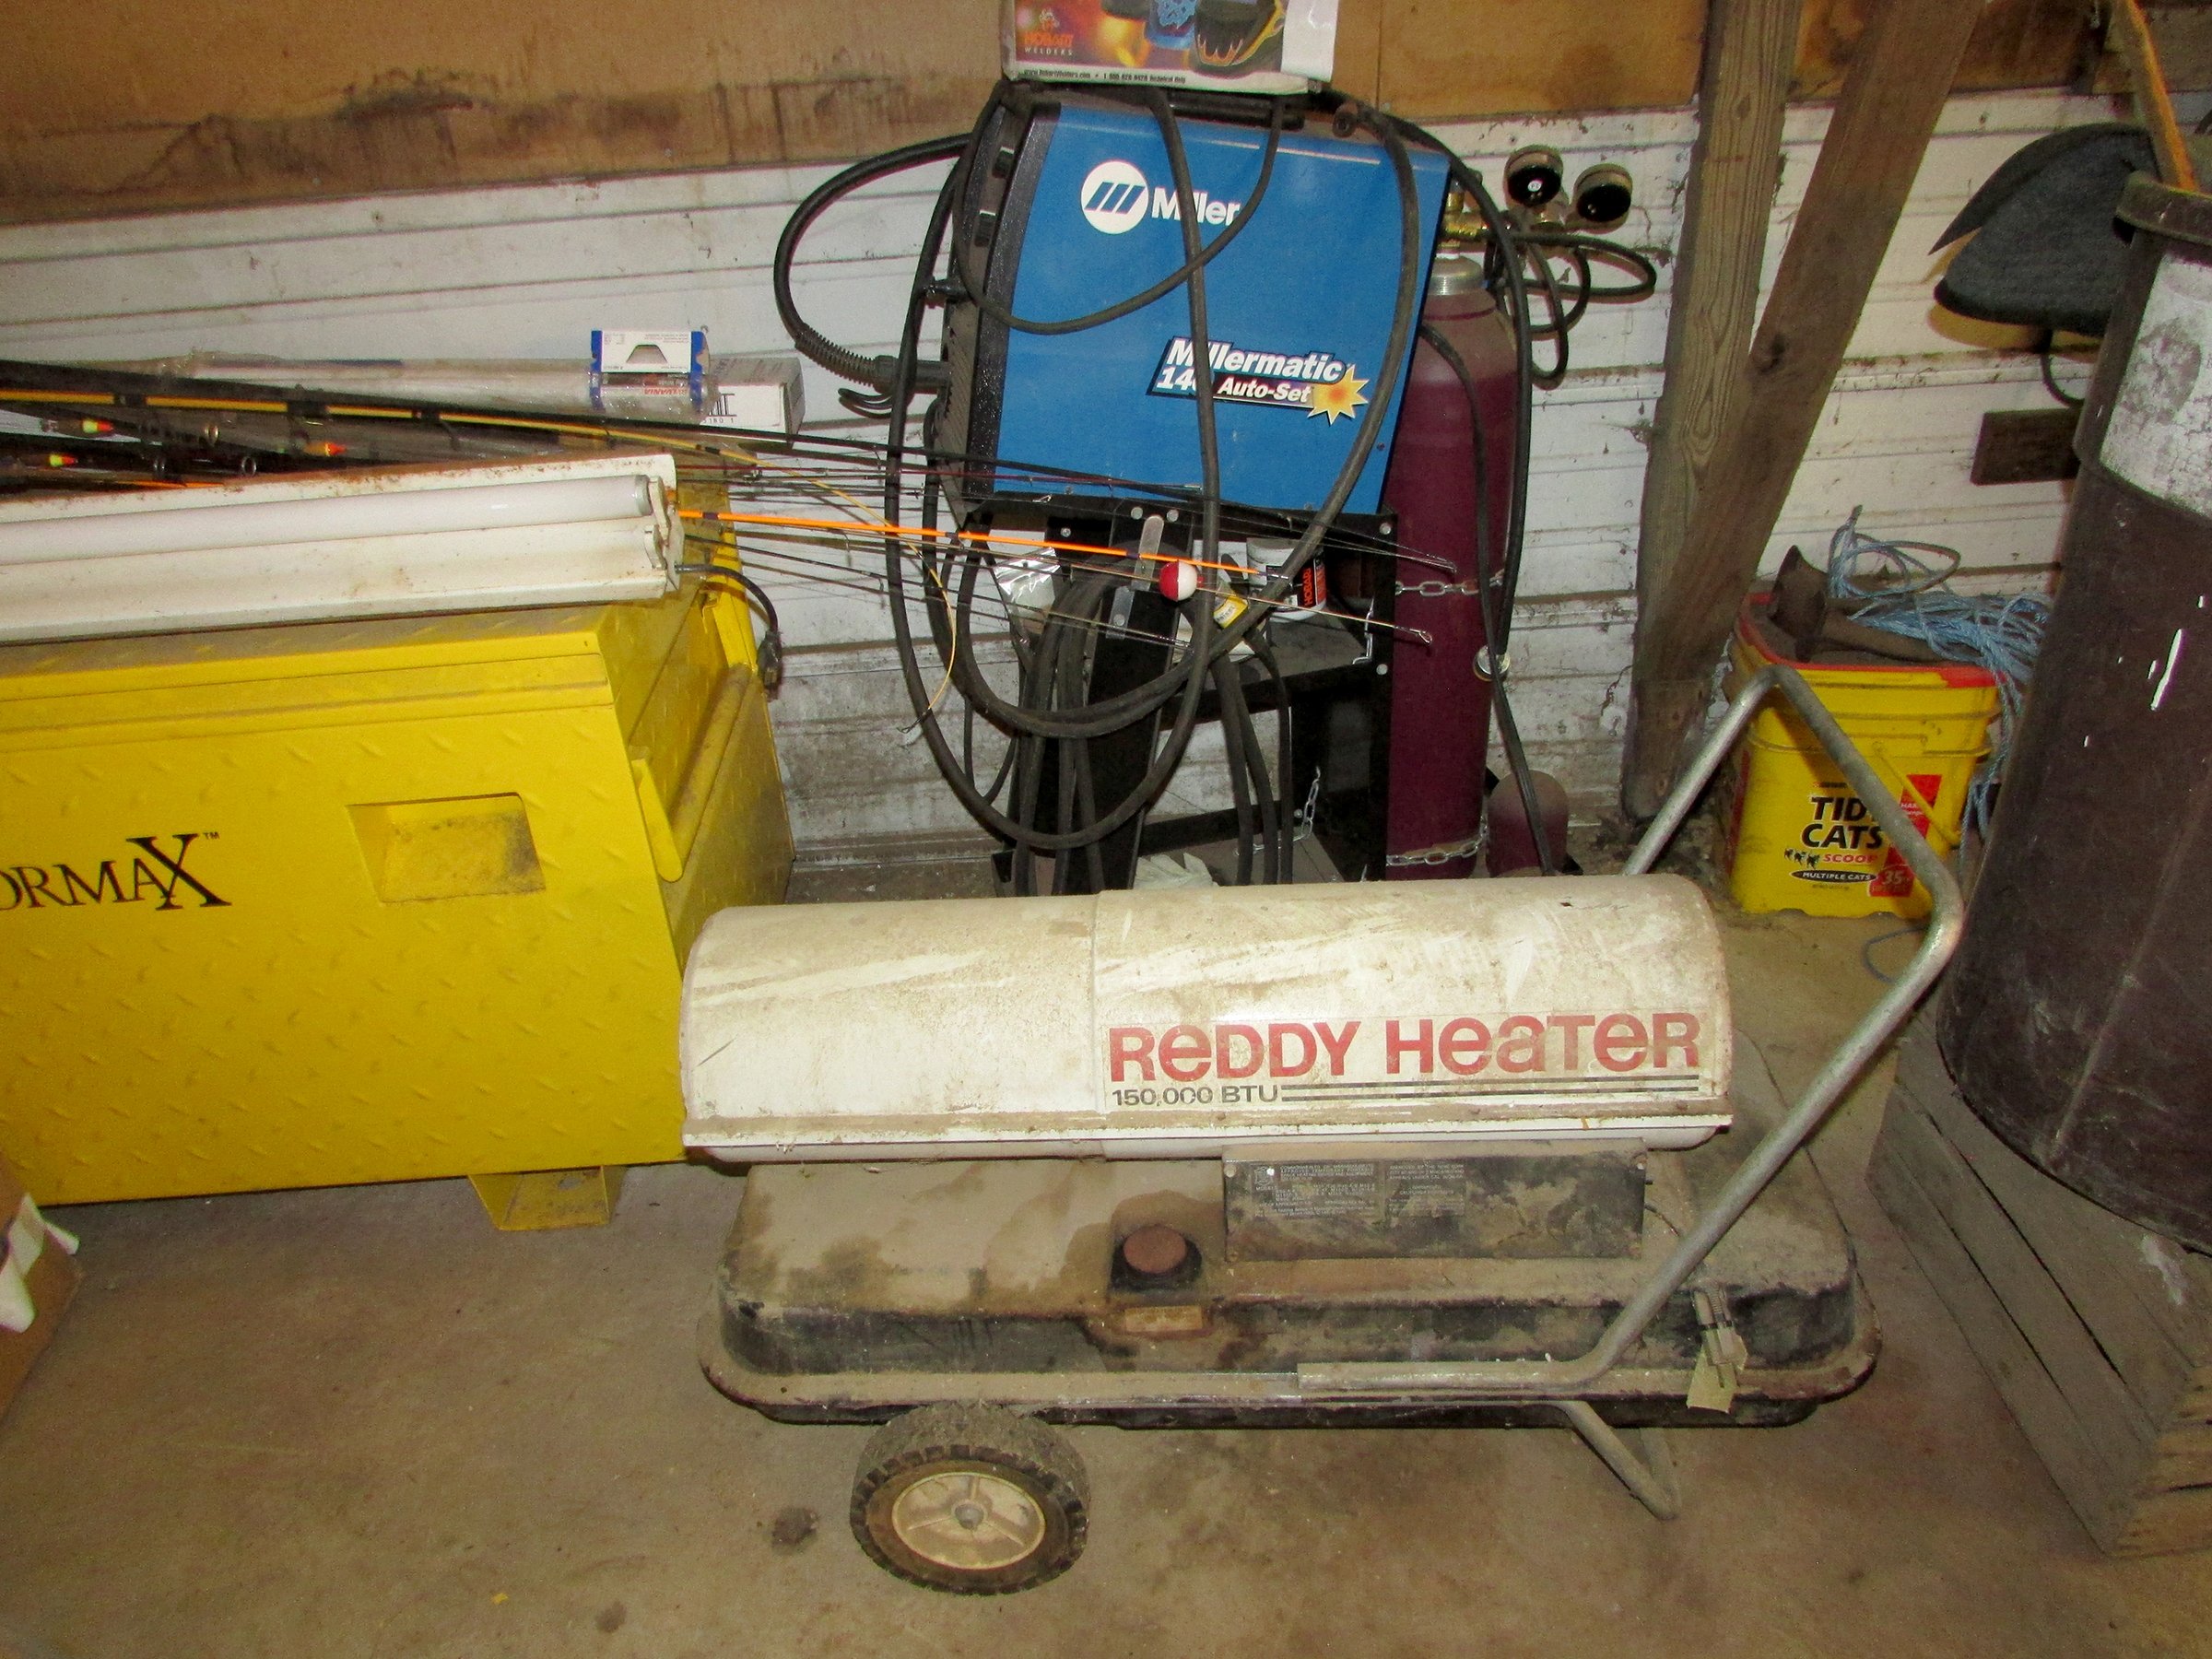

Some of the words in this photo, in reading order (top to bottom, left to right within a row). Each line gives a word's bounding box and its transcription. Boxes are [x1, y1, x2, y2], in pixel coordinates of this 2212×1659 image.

[1151, 187, 1241, 227] Mler
[1166, 339, 1342, 382] Mllermatic
[1156, 367, 1197, 391] 14
[1217, 376, 1312, 403] Auto-Set
[1302, 566, 1313, 606] HOBAR
[1810, 795, 1867, 821] TID
[1801, 823, 1883, 849] CATS
[1823, 853, 1878, 864] SCOOP
[1803, 872, 1845, 880] MULTIPLE
[1112, 1084, 1214, 1107] 150,000
[1221, 1083, 1279, 1104] BTU
